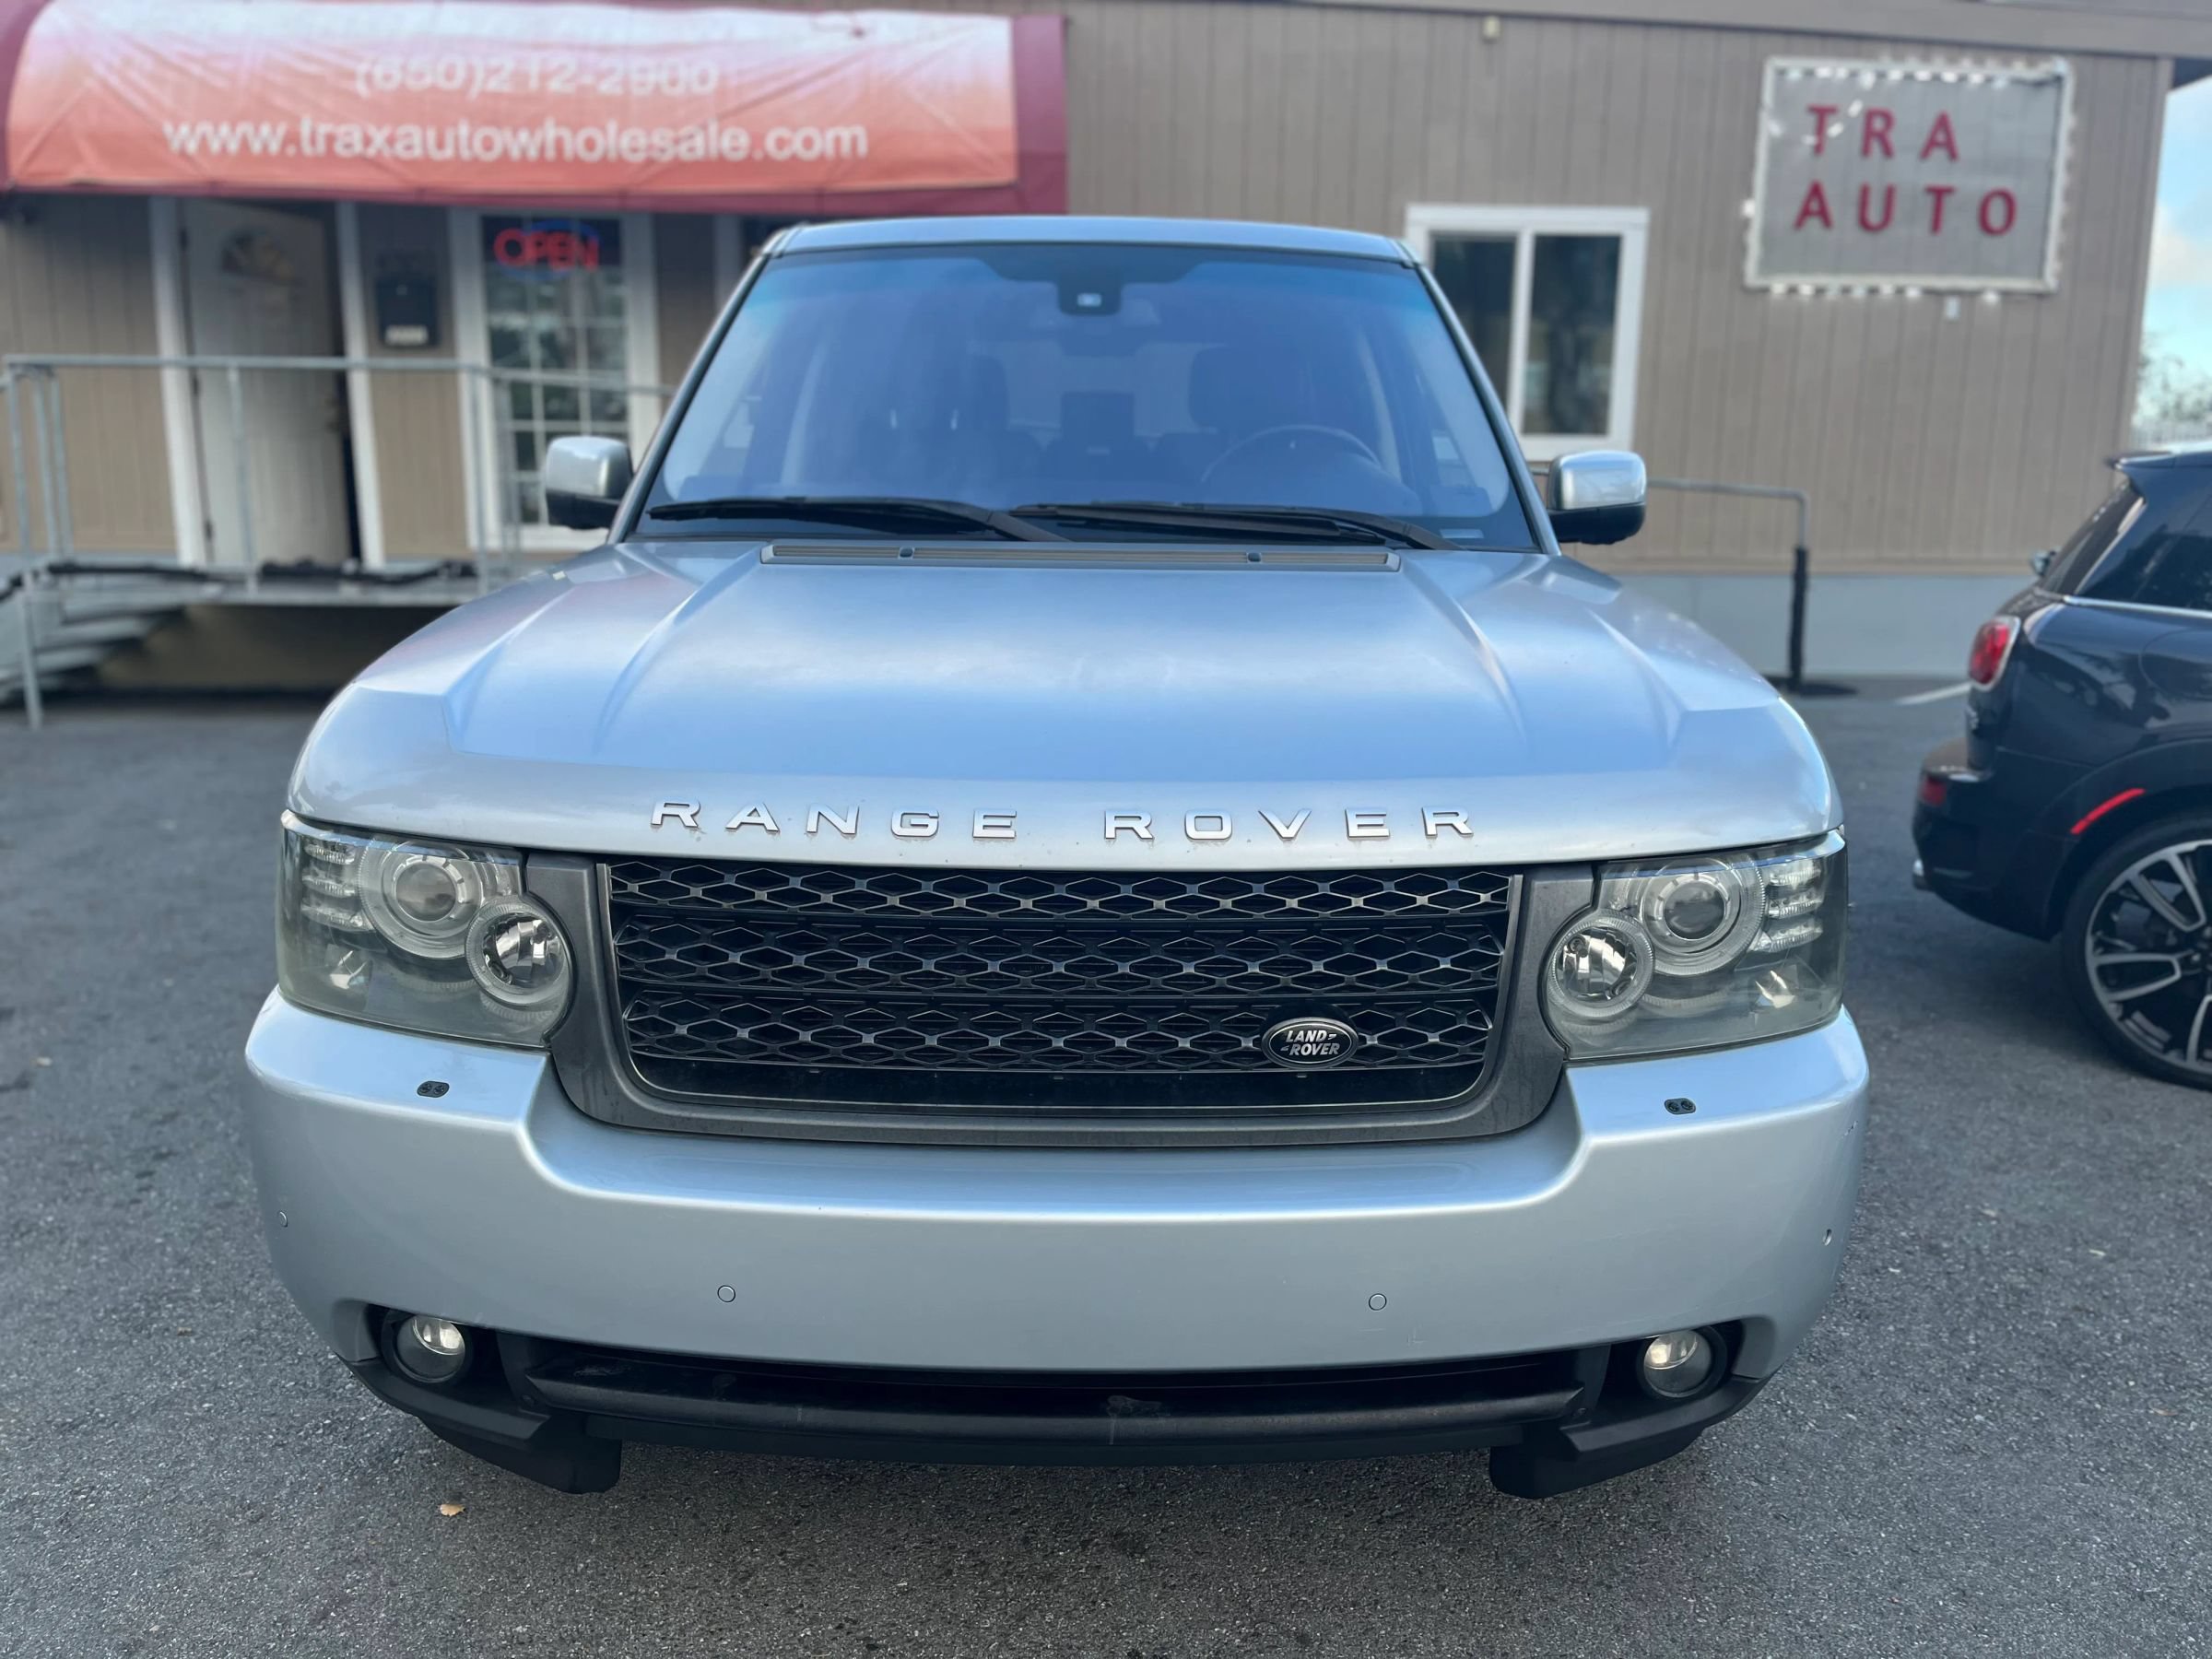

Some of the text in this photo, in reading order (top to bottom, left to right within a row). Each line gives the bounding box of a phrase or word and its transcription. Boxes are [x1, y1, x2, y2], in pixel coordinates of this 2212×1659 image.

[162, 116, 869, 163] www.traxautowholesale.com
[1806, 104, 1958, 160] TRA
[1794, 180, 2017, 235] AUTO
[494, 228, 599, 272] OPEN
[651, 800, 1473, 841] RANGE ROVER
[1286, 1030, 1327, 1042] LAND
[1289, 1042, 1341, 1055] ROVER
